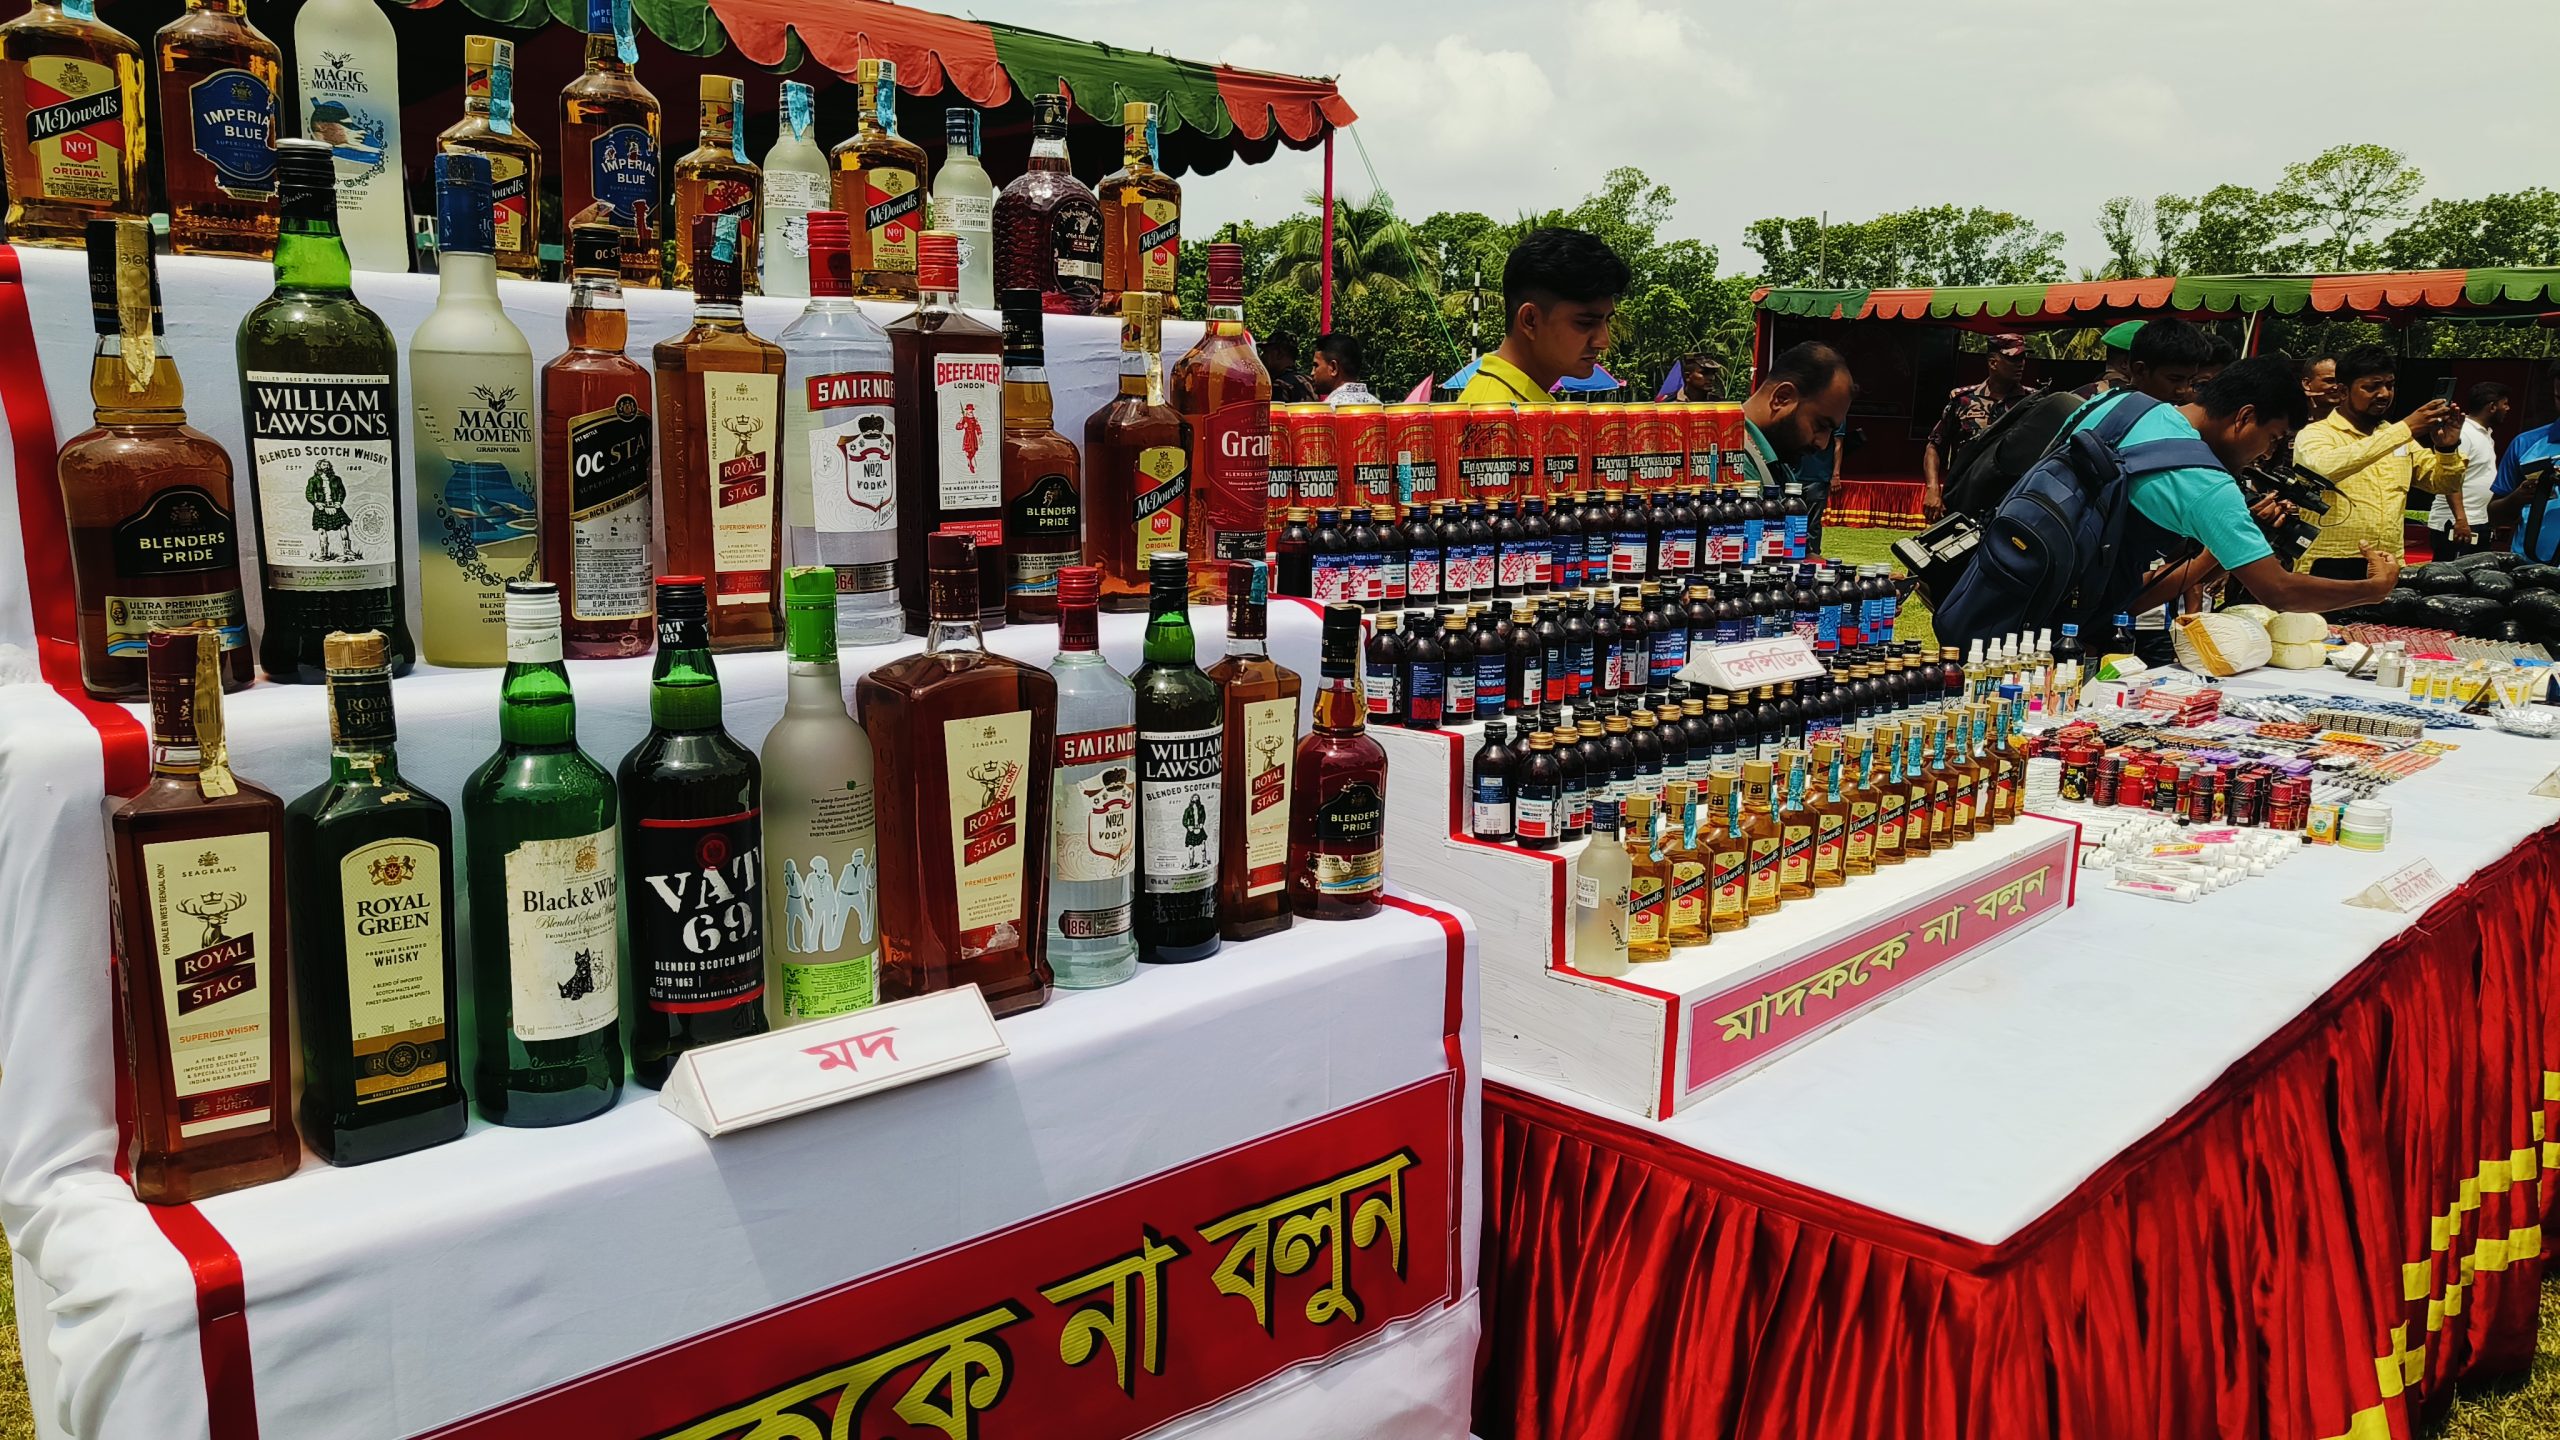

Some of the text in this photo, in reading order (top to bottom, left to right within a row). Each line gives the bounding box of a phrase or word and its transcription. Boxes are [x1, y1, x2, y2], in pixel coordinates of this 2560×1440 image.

[313, 68, 364, 84] MAGIC
[312, 80, 368, 93] MOMENTS
[34, 96, 118, 138] McDowell's
[224, 126, 262, 140] BLUE
[53, 167, 107, 178] ORIGINAL
[601, 158, 656, 177] IMPERIAL
[617, 173, 645, 185] BLUE
[869, 193, 917, 228] McDowell's
[595, 249, 608, 260] OC
[937, 363, 1000, 386] BEEFEATER
[258, 388, 379, 411] WILLIAM
[255, 412, 389, 436] LAWSON'S
[458, 410, 528, 429] MAGIC
[453, 427, 531, 443] MOMENTS
[259, 446, 388, 465] BLENDED SCOTCH WHISKY
[576, 451, 605, 477] OC
[724, 457, 762, 477] ROYAL
[727, 484, 757, 501] STAG
[857, 480, 887, 490] VODKA
[1300, 483, 1334, 497] 5000
[1136, 476, 1185, 518] McDowell's
[589, 507, 605, 518] RICH
[1027, 506, 1076, 516] BLENDERS
[1040, 517, 1069, 526] PRIDE
[140, 532, 225, 549] BLENDERS
[163, 549, 213, 563] PRIDE
[129, 600, 209, 610] ULTRA PREMIUM
[658, 621, 684, 634] VAT
[1151, 736, 1221, 761] WILLIAM
[1006, 764, 1019, 784] ONLY
[1255, 770, 1282, 789] ROYAL
[1146, 782, 1210, 801] BLENDED SCOTCH
[1257, 790, 1279, 810] STAG
[969, 804, 1011, 832] ROYAL
[1331, 810, 1379, 822] BLENDERS
[1099, 829, 1127, 840] VODKA
[1343, 821, 1371, 832] PRIDE
[973, 833, 1007, 858] STAG
[182, 866, 237, 877] SEAGRAM'S
[645, 847, 760, 913] VAT
[965, 872, 1016, 887] PREMIER WHISKY
[356, 893, 430, 917] ROYAL
[522, 888, 578, 912] Black
[581, 886, 594, 906] &
[157, 863, 171, 955] FOR SALE IN WEST BENGAL ONLY
[357, 912, 429, 936] GREEN
[535, 914, 578, 929] Blended
[1067, 919, 1092, 935] 1864
[564, 930, 582, 939] JAMES
[184, 942, 246, 975] ROYAL
[365, 943, 427, 957] PREMIUM BLENDED
[1714, 864, 2051, 1042] মাদককে না বলুন
[374, 951, 419, 967] WHISKY
[655, 961, 696, 972] BLENDED
[700, 956, 735, 970] SCOTCH
[400, 976, 423, 984] IMPORTED
[192, 975, 242, 1005] STAG
[414, 990, 431, 998] SPIRITS
[179, 1024, 260, 1043] SUPERIOR WHISKY
[800, 1026, 899, 1072] মদ
[183, 1055, 260, 1073] IMPORTED SCOTCH MALTS
[193, 1063, 257, 1078] SPECIALLY SELECTED
[373, 1059, 384, 1069] R
[189, 1069, 256, 1086] INDIAN SPIRITS
[1040, 1231, 1178, 1386] না
[1200, 1153, 1412, 1330] বলুন
